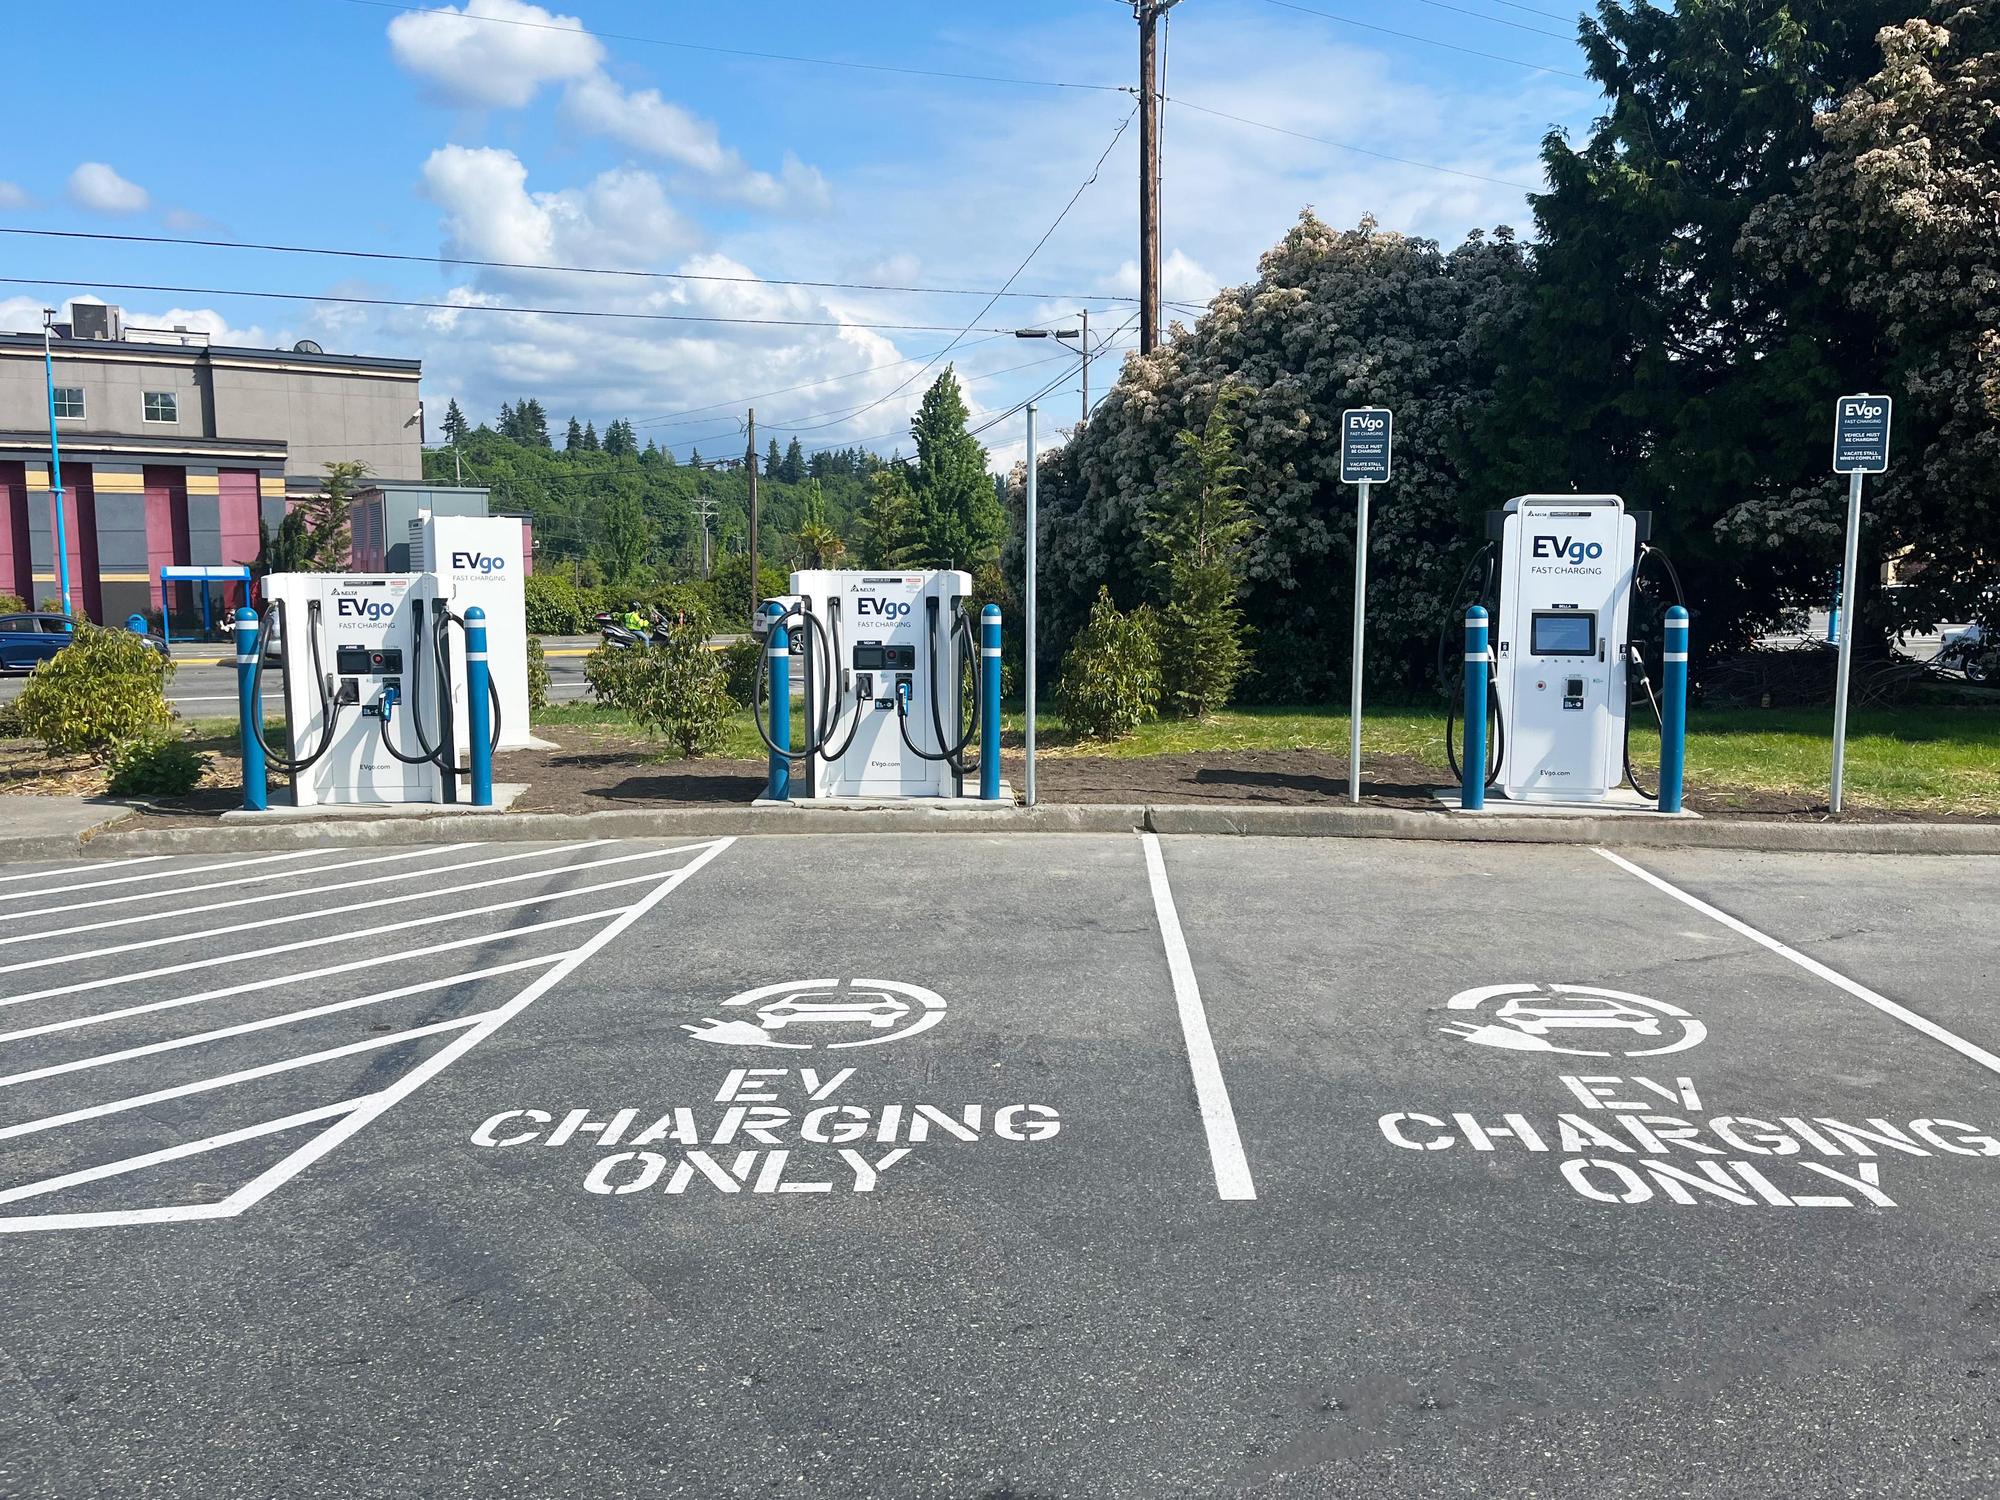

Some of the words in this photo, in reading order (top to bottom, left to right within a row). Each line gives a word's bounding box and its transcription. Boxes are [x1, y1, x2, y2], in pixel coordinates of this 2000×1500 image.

[1845, 403, 1882, 419] EVgo
[1350, 416, 1384, 431] EVgo
[1532, 535, 1603, 565] EVgo
[452, 552, 505, 574] EVgo
[1531, 566, 1553, 574] FAST
[1554, 566, 1602, 575] CHARGING
[338, 598, 395, 621] EVgo
[857, 597, 911, 620] EVgo
[871, 760, 901, 768] EVgo.com
[1540, 769, 1571, 777] EVgo.com
[713, 1068, 857, 1101] EV
[1559, 1076, 1703, 1111] EV
[470, 1104, 1061, 1147] CHARGING
[1378, 1112, 2000, 1157] CHARGING
[583, 1148, 912, 1195] ONLY
[1559, 1159, 1898, 1208] ONLY
